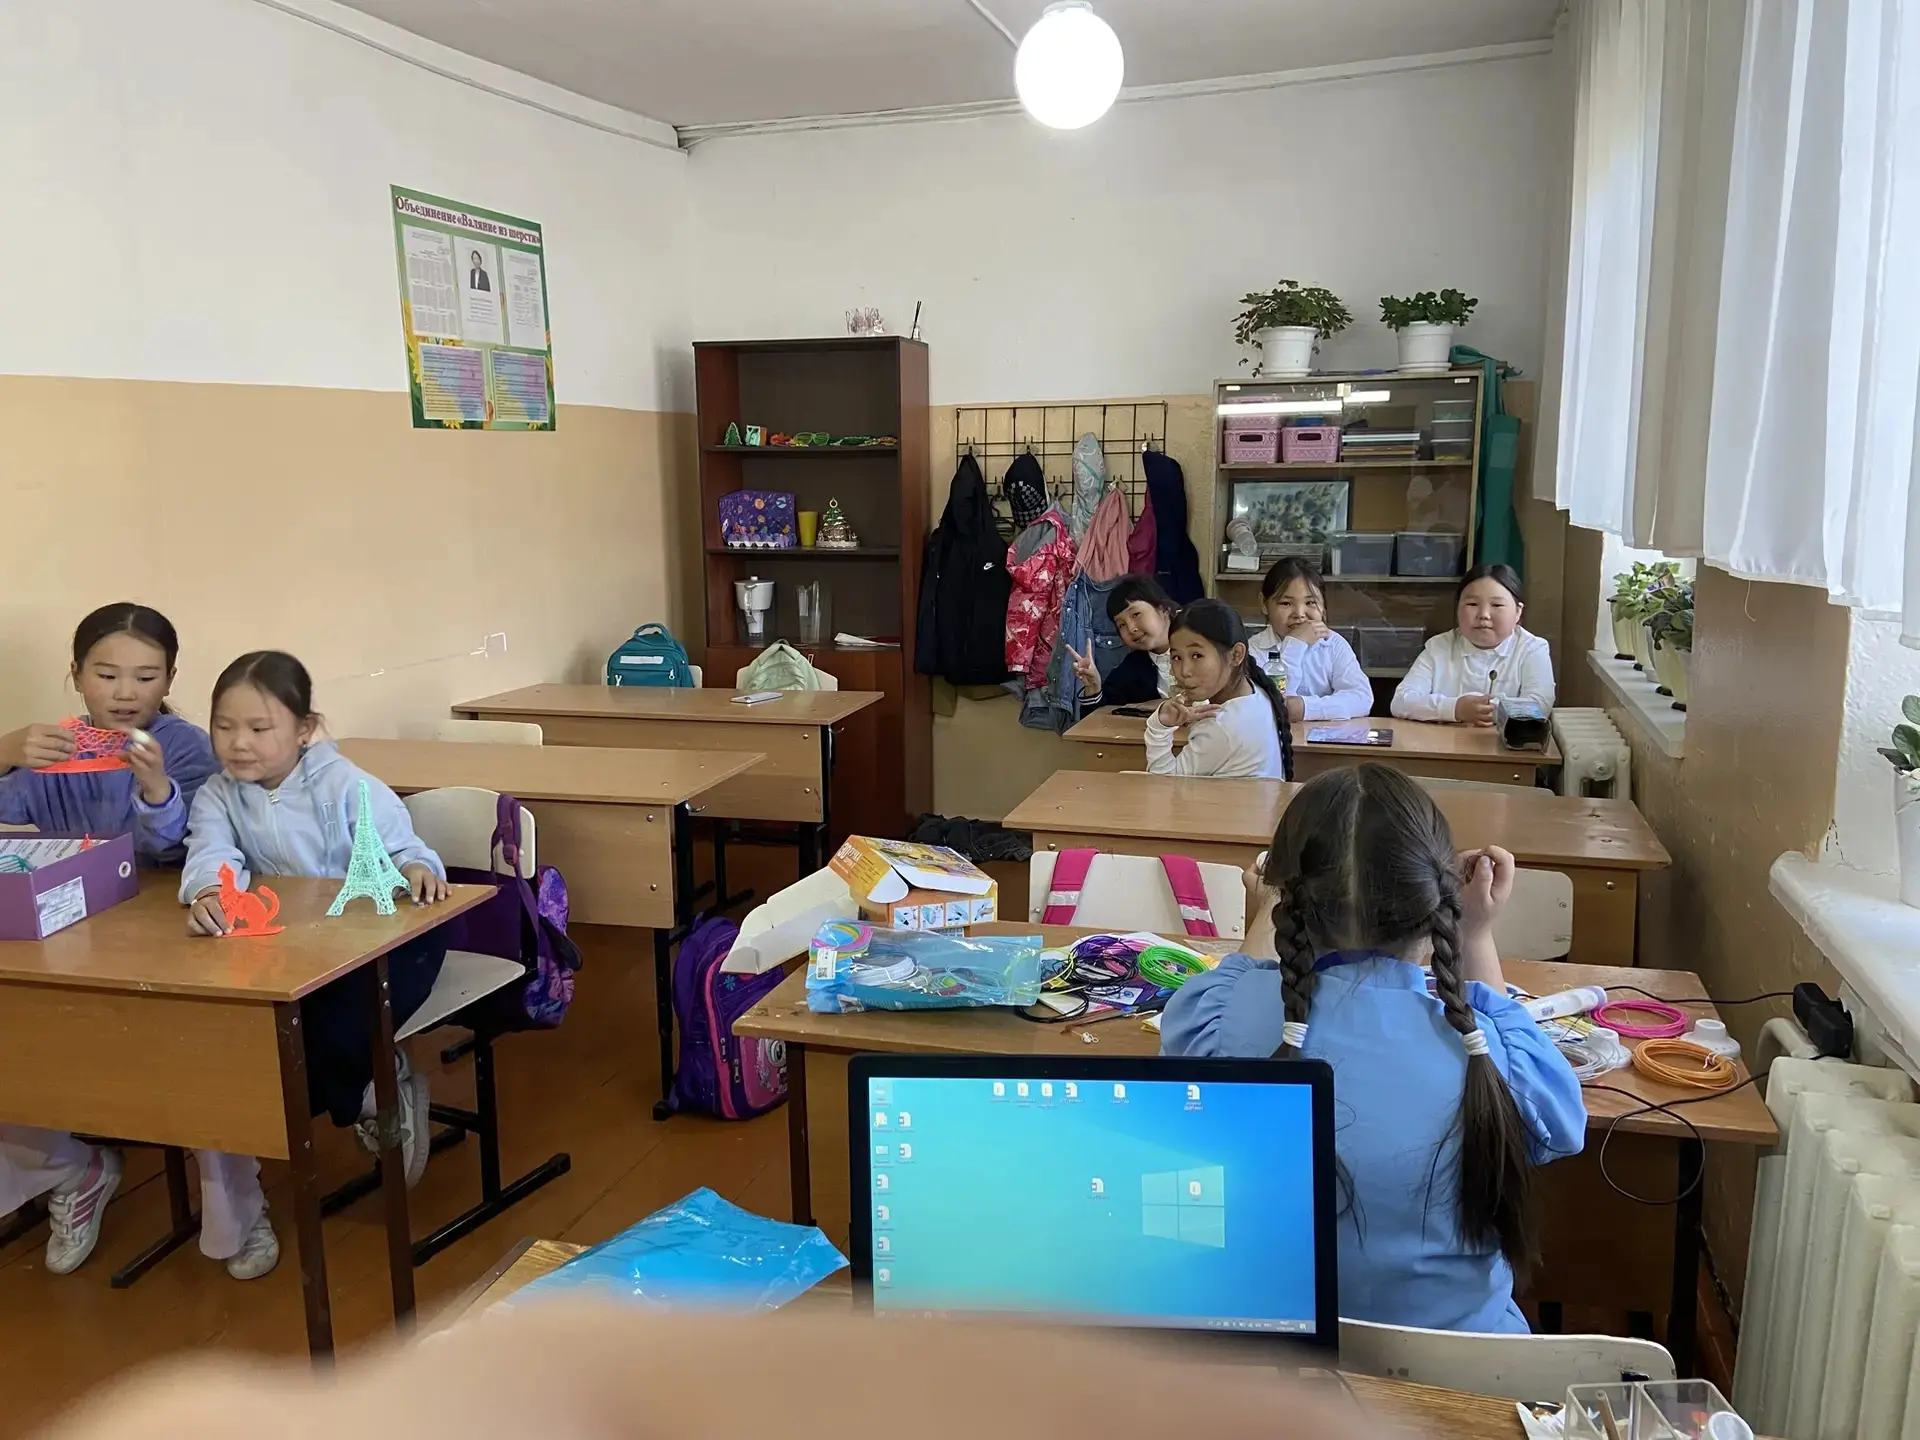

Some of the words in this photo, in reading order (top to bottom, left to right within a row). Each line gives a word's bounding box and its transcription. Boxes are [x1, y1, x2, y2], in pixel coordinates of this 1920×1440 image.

[395, 196, 457, 224] Объединение
[457, 213, 498, 234] «Валяние
[498, 225, 508, 237] из
[508, 228, 541, 244] шерсти»
